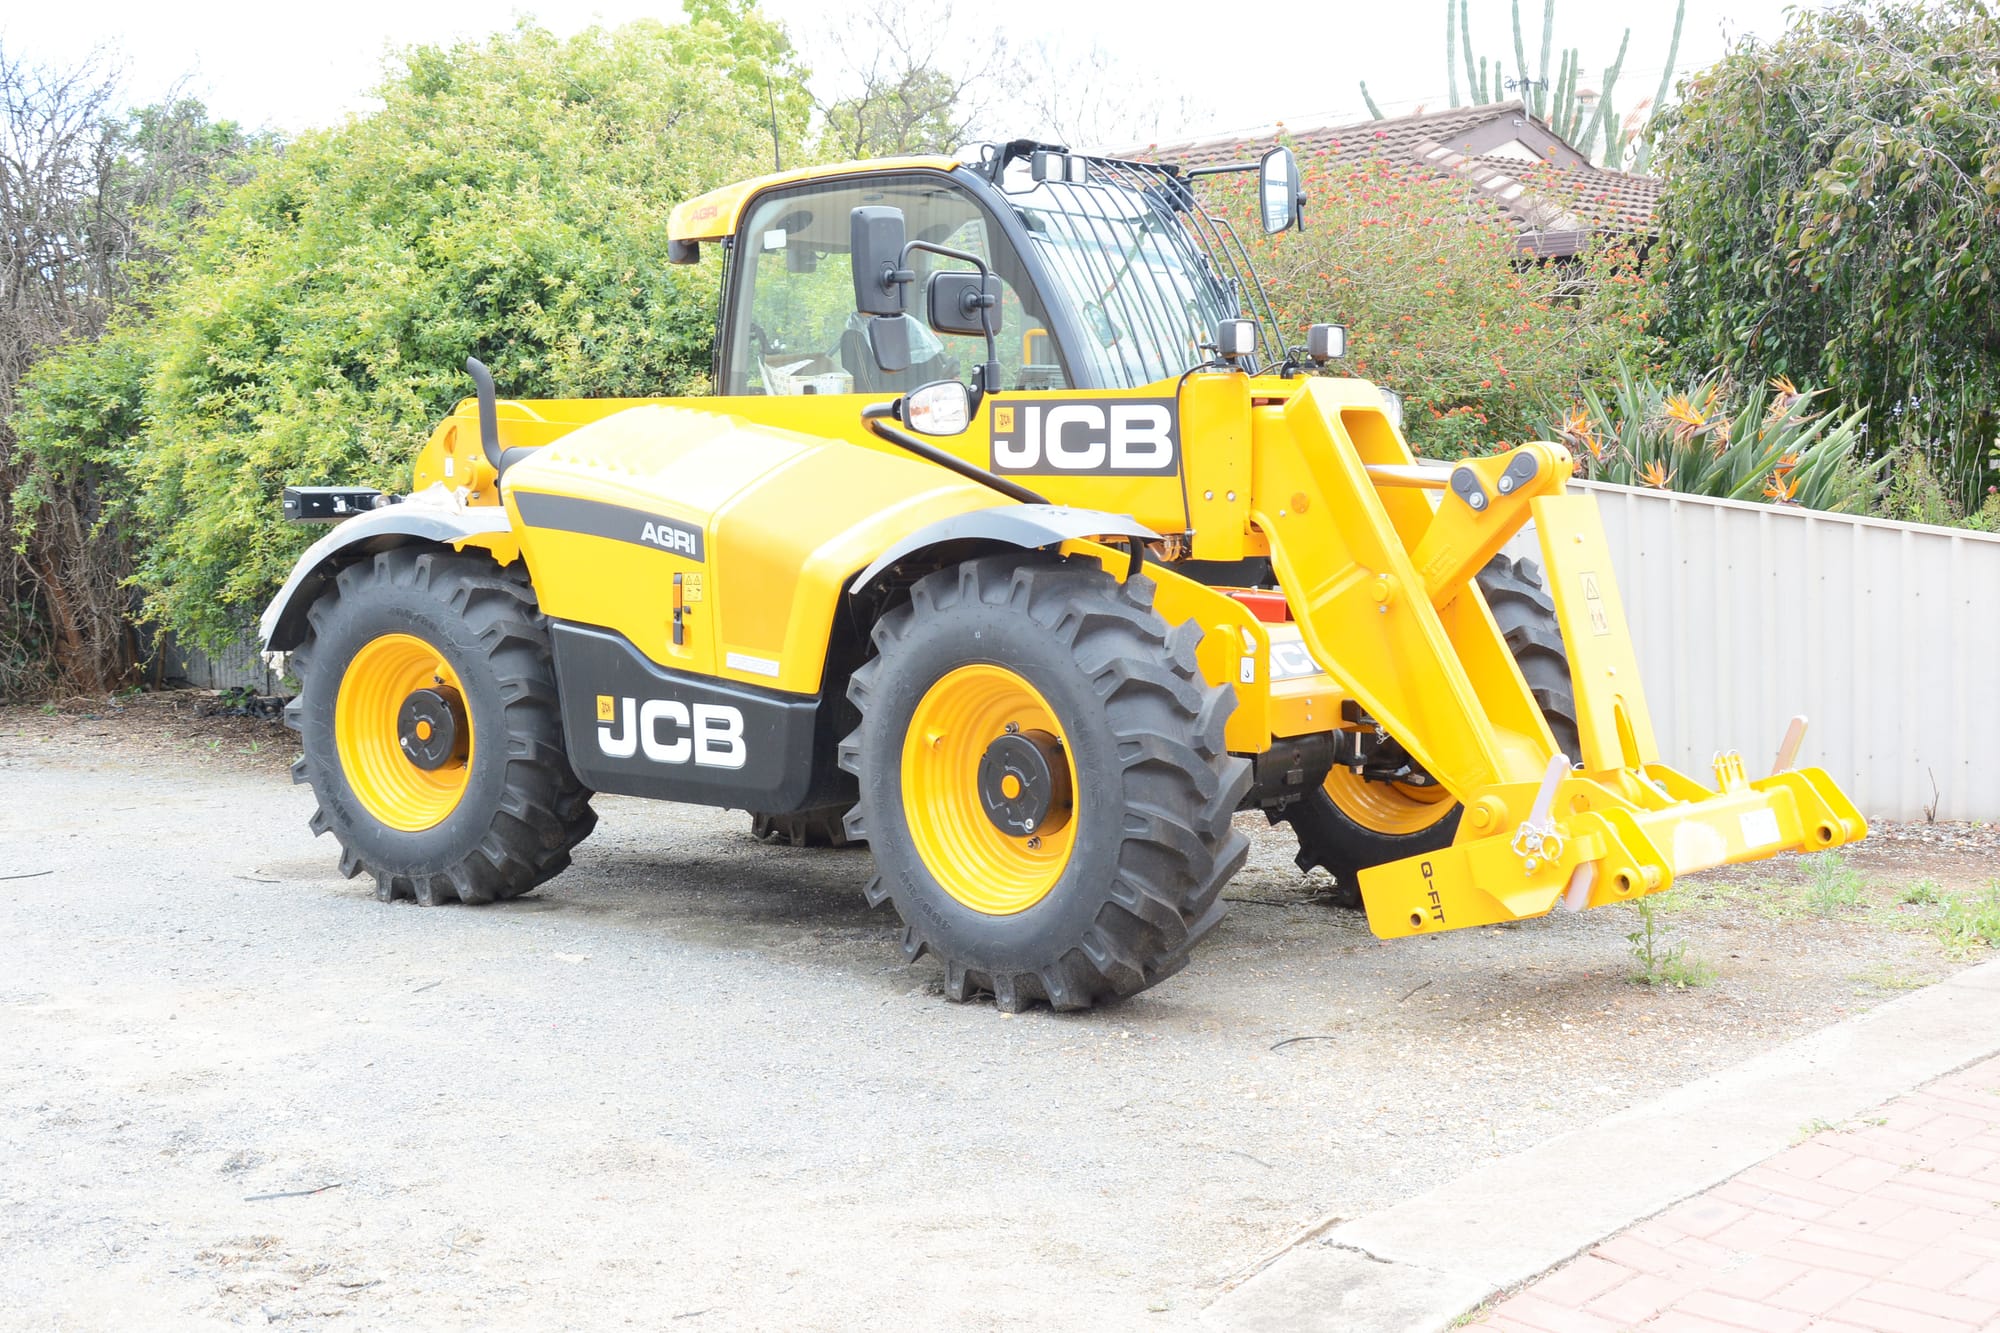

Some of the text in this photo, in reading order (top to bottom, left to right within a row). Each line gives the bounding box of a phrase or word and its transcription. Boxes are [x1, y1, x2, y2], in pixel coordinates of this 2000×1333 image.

[691, 206, 717, 221] AGRI
[994, 404, 1173, 469] JCB
[641, 521, 696, 555] AGRI
[597, 697, 746, 770] JCB
[1421, 861, 1445, 923] Q-FIT
